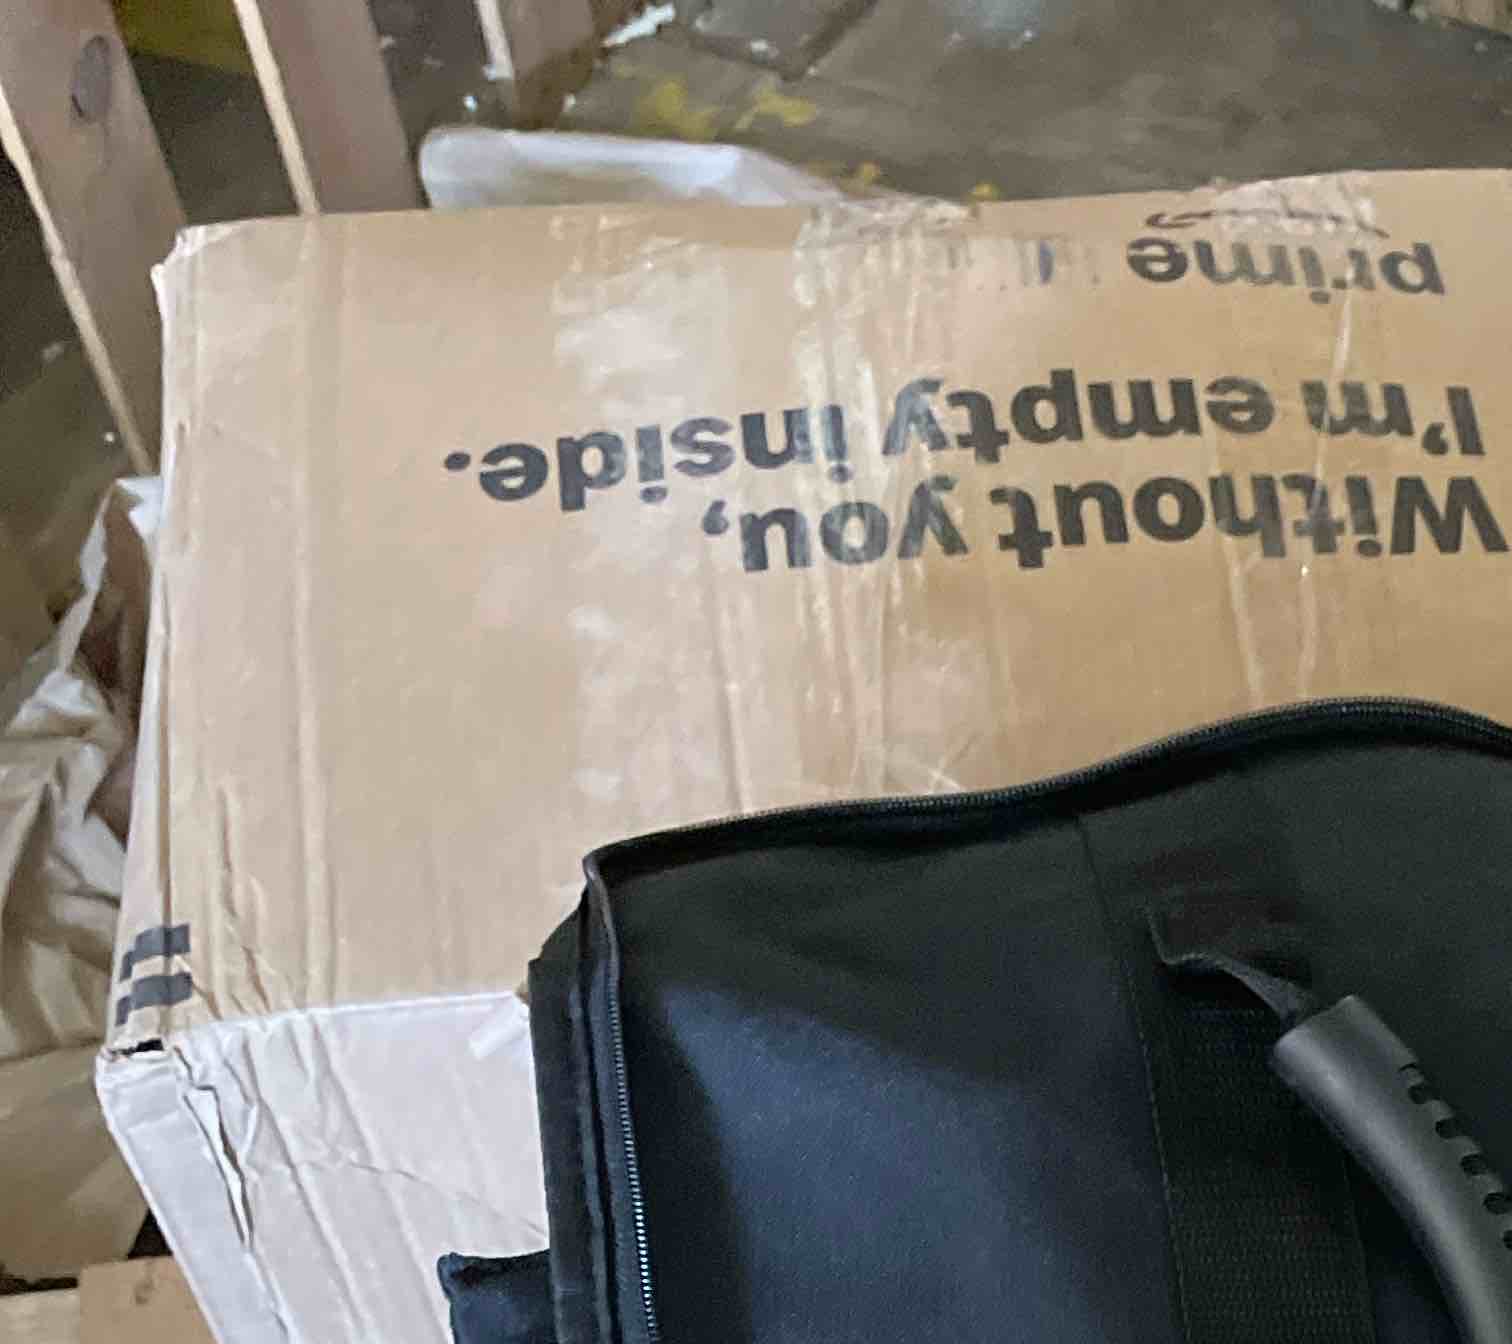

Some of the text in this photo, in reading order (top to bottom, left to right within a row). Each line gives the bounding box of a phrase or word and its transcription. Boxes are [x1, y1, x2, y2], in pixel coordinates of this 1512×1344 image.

[1127, 237, 1446, 308] prime
[441, 369, 1487, 511] I'm empty inside.
[703, 469, 1509, 574] Without you,
